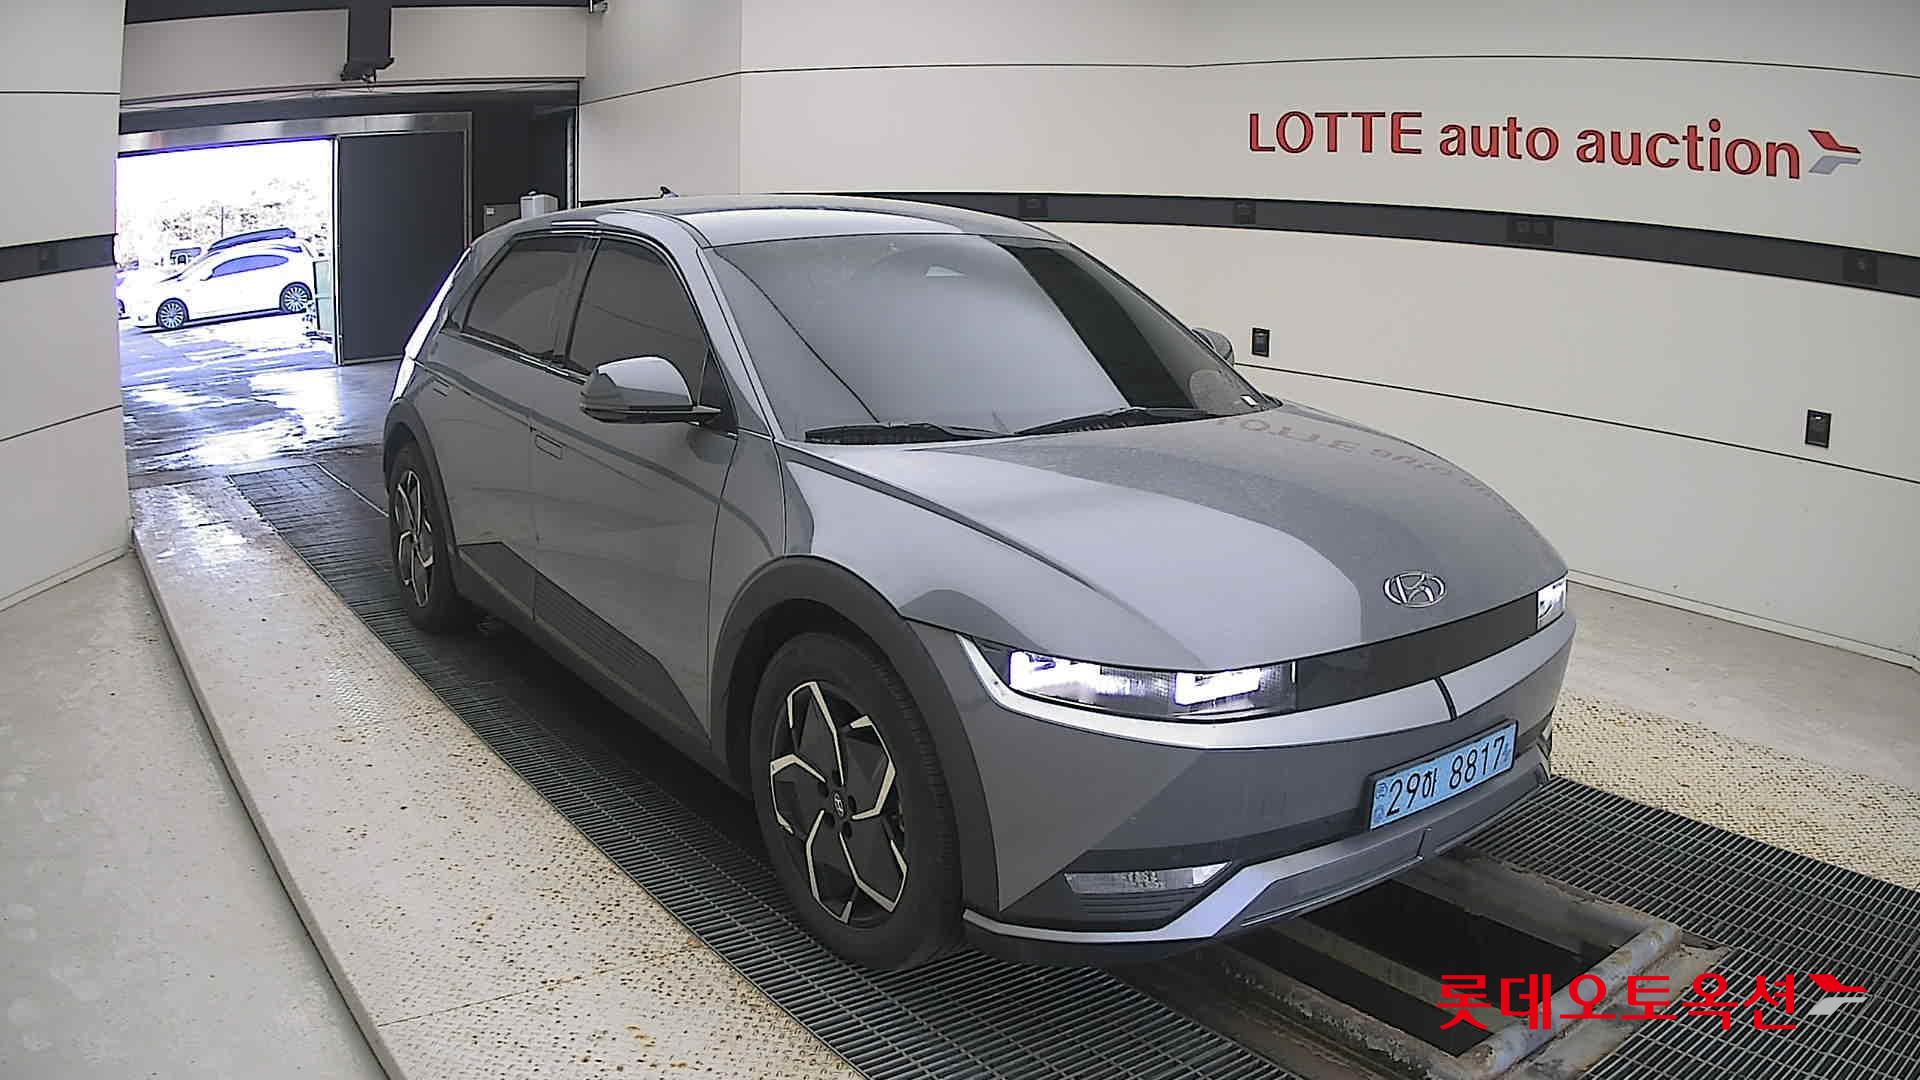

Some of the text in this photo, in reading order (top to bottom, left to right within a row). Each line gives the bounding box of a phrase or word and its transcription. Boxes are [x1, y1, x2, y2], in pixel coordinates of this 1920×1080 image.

[1249, 111, 1801, 180] LOTTE auto auction
[1386, 735, 1505, 817] 29하 8817
